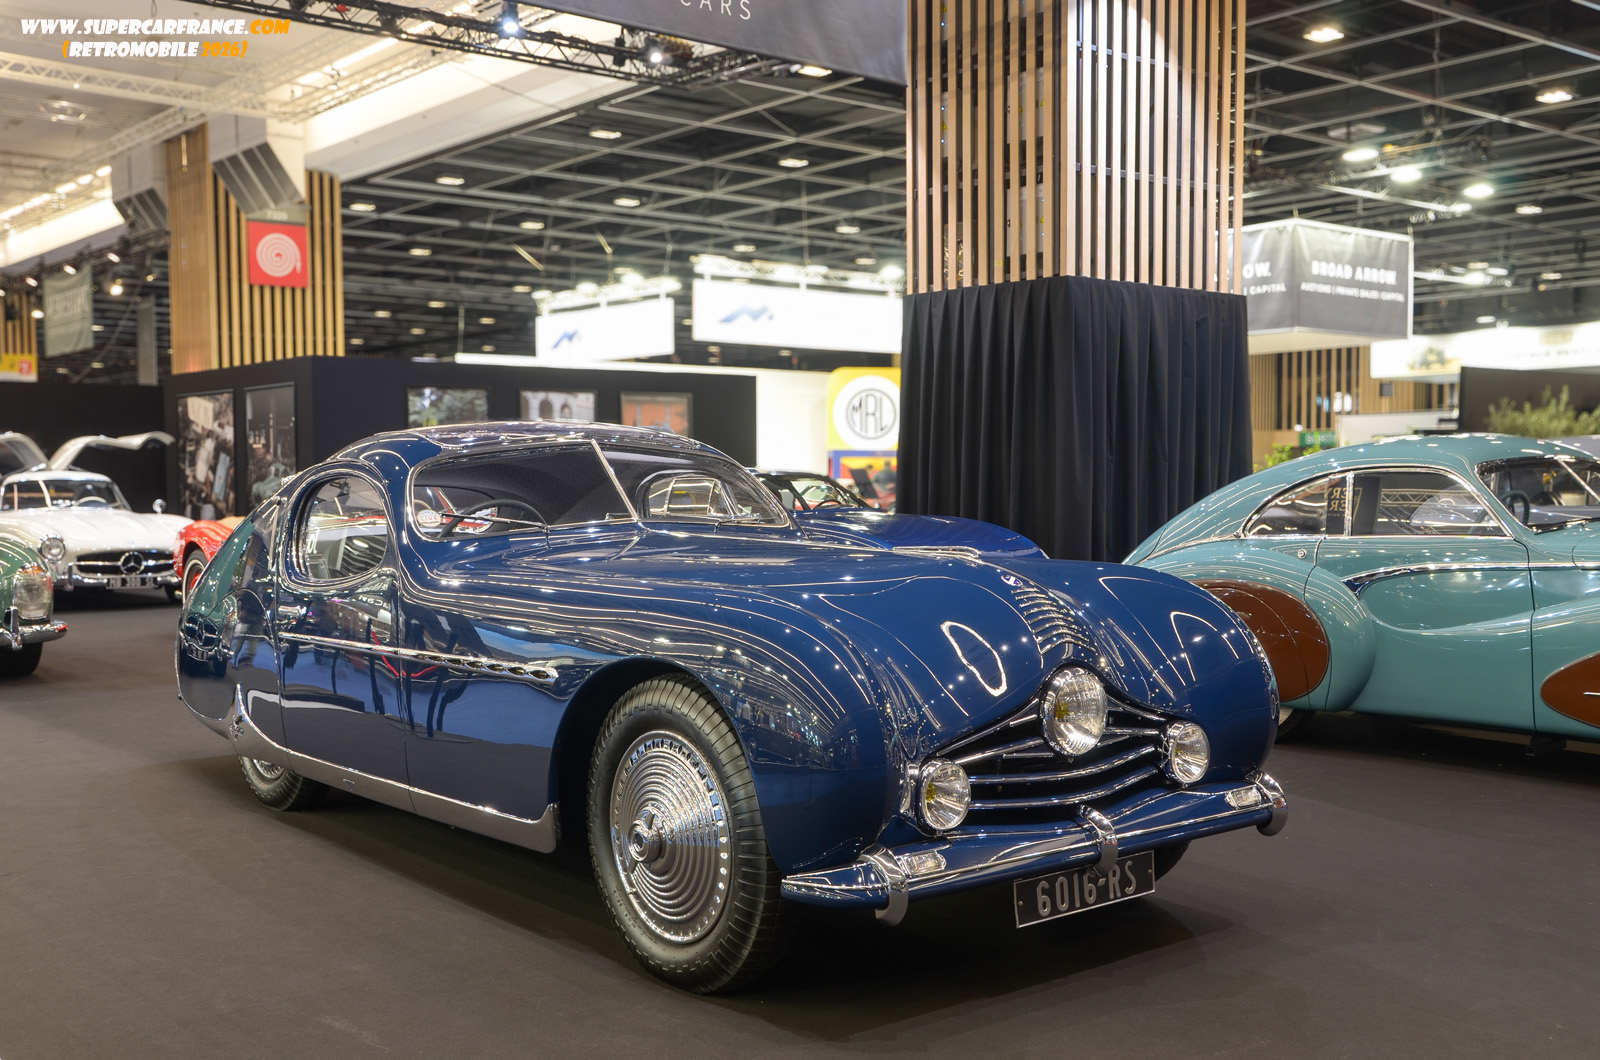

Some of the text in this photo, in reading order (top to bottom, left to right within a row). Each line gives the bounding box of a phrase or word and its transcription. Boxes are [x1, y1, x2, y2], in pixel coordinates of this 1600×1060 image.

[681, 0, 751, 20] ARS
[1311, 260, 1353, 280] BROAD
[1249, 282, 1287, 296] CAPITAL
[1300, 281, 1331, 294] AUCTIONS
[1036, 860, 1137, 917] 6016-RS
